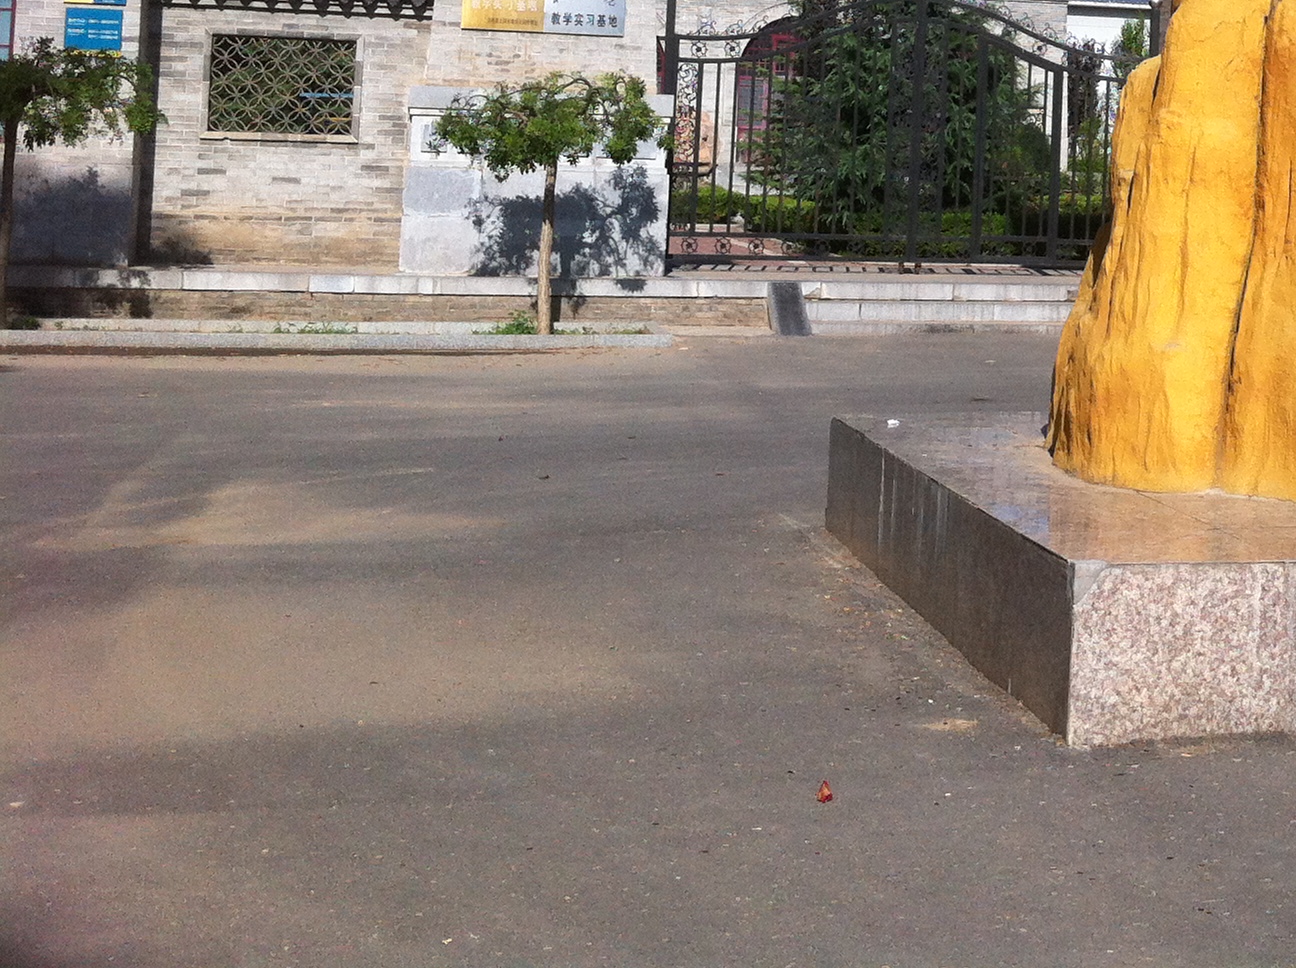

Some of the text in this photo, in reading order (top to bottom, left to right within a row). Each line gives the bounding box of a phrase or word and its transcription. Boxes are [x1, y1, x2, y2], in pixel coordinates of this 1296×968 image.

[551, 12, 618, 28] 教学实习基地
